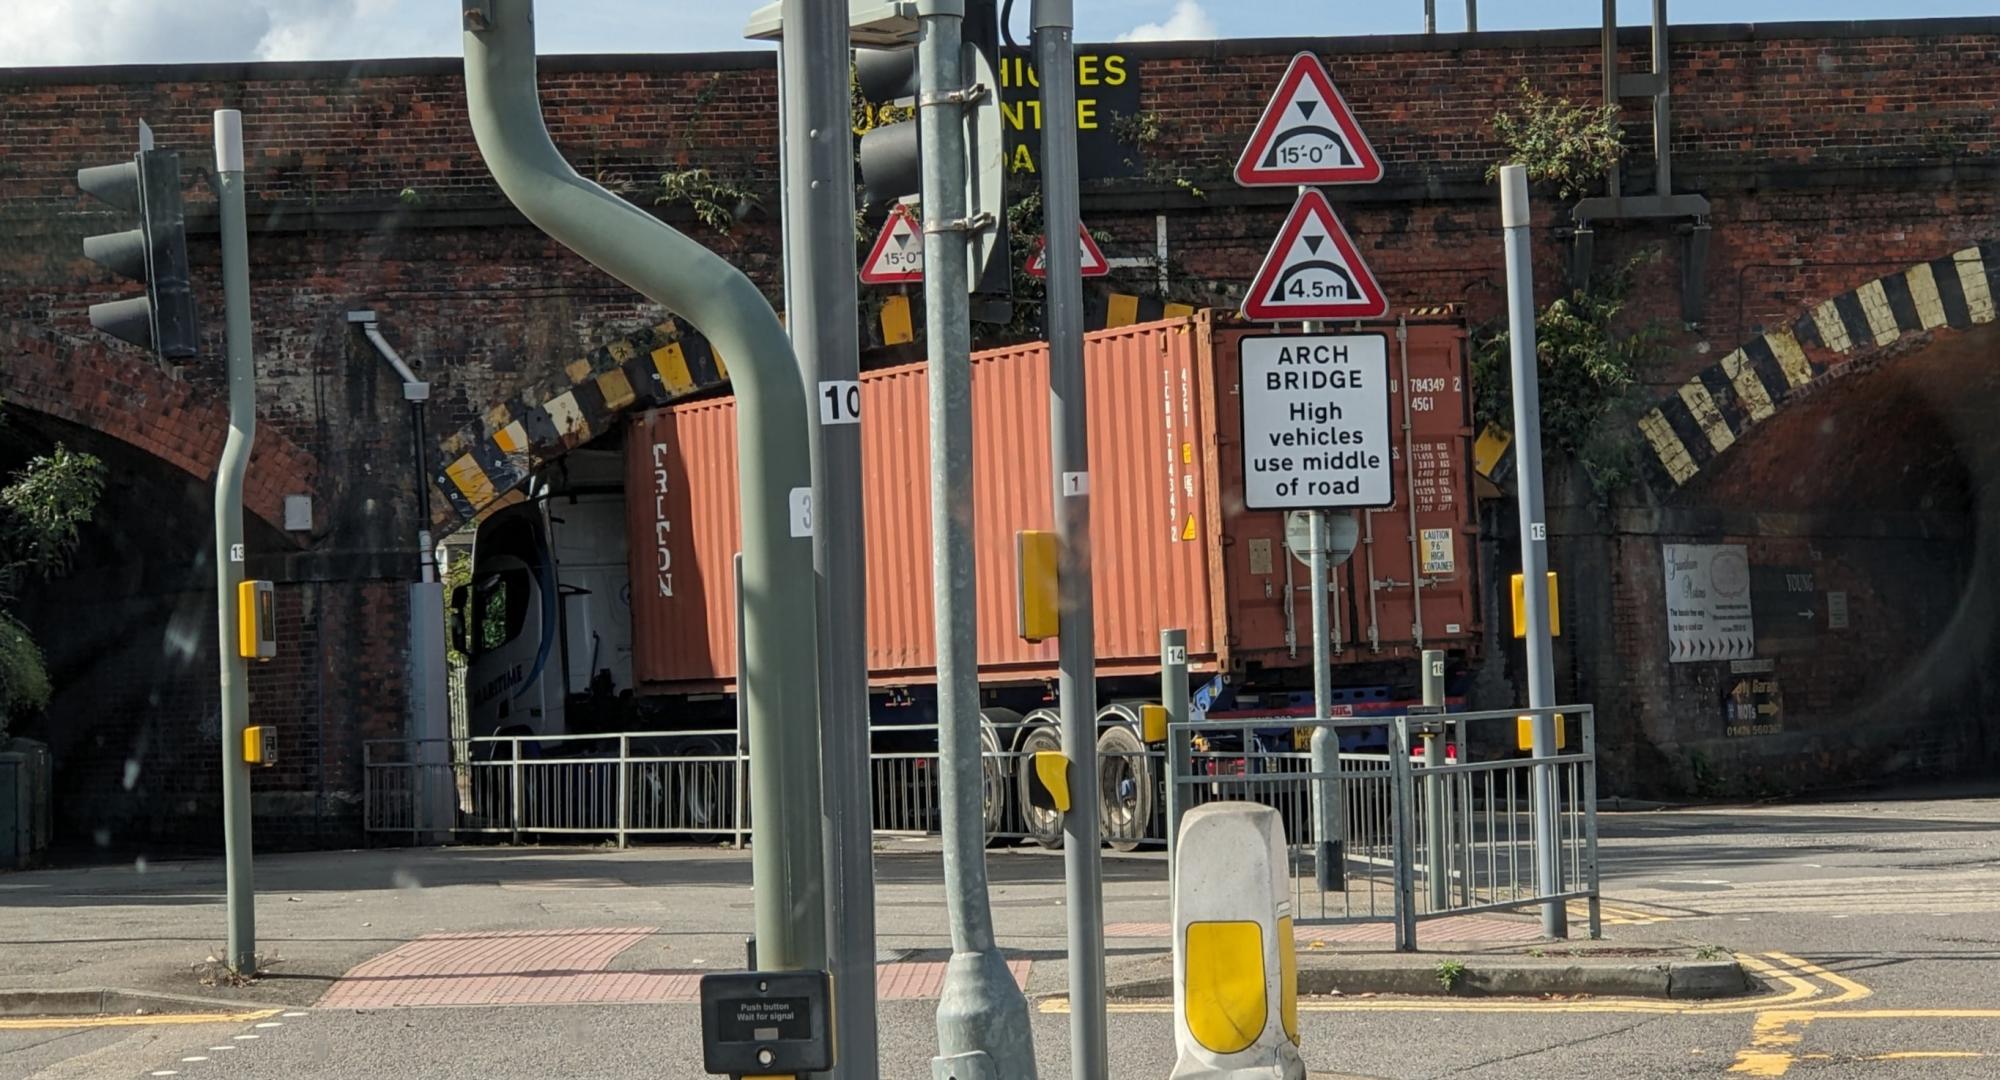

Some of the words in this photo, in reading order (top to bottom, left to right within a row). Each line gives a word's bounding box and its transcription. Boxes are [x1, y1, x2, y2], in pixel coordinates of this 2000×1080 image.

[1288, 279, 1343, 298] 4.5m
[1278, 345, 1349, 365] ARCH
[1266, 370, 1363, 390] BRIDGE
[1410, 378, 1445, 393] 784349
[1453, 376, 1462, 393] 2
[825, 385, 861, 420] 10
[1411, 397, 1434, 411] 45G1
[1289, 402, 1342, 424] High
[1269, 427, 1364, 447] vehicles
[1254, 457, 1294, 472] use
[1303, 451, 1380, 471] middle
[1072, 475, 1078, 492] 1
[1276, 478, 1298, 496] of
[1308, 476, 1360, 495] road
[1423, 530, 1449, 540] CAUTION
[1532, 527, 1545, 539] 15
[1430, 551, 1444, 560] HIGH
[1423, 561, 1453, 572] CONTAINER
[1170, 649, 1184, 662] 14
[741, 1003, 761, 1012] Push
[763, 1003, 789, 1011] button
[737, 1013, 755, 1021] Wait
[756, 1012, 768, 1020] for
[770, 1011, 794, 1022] signal
